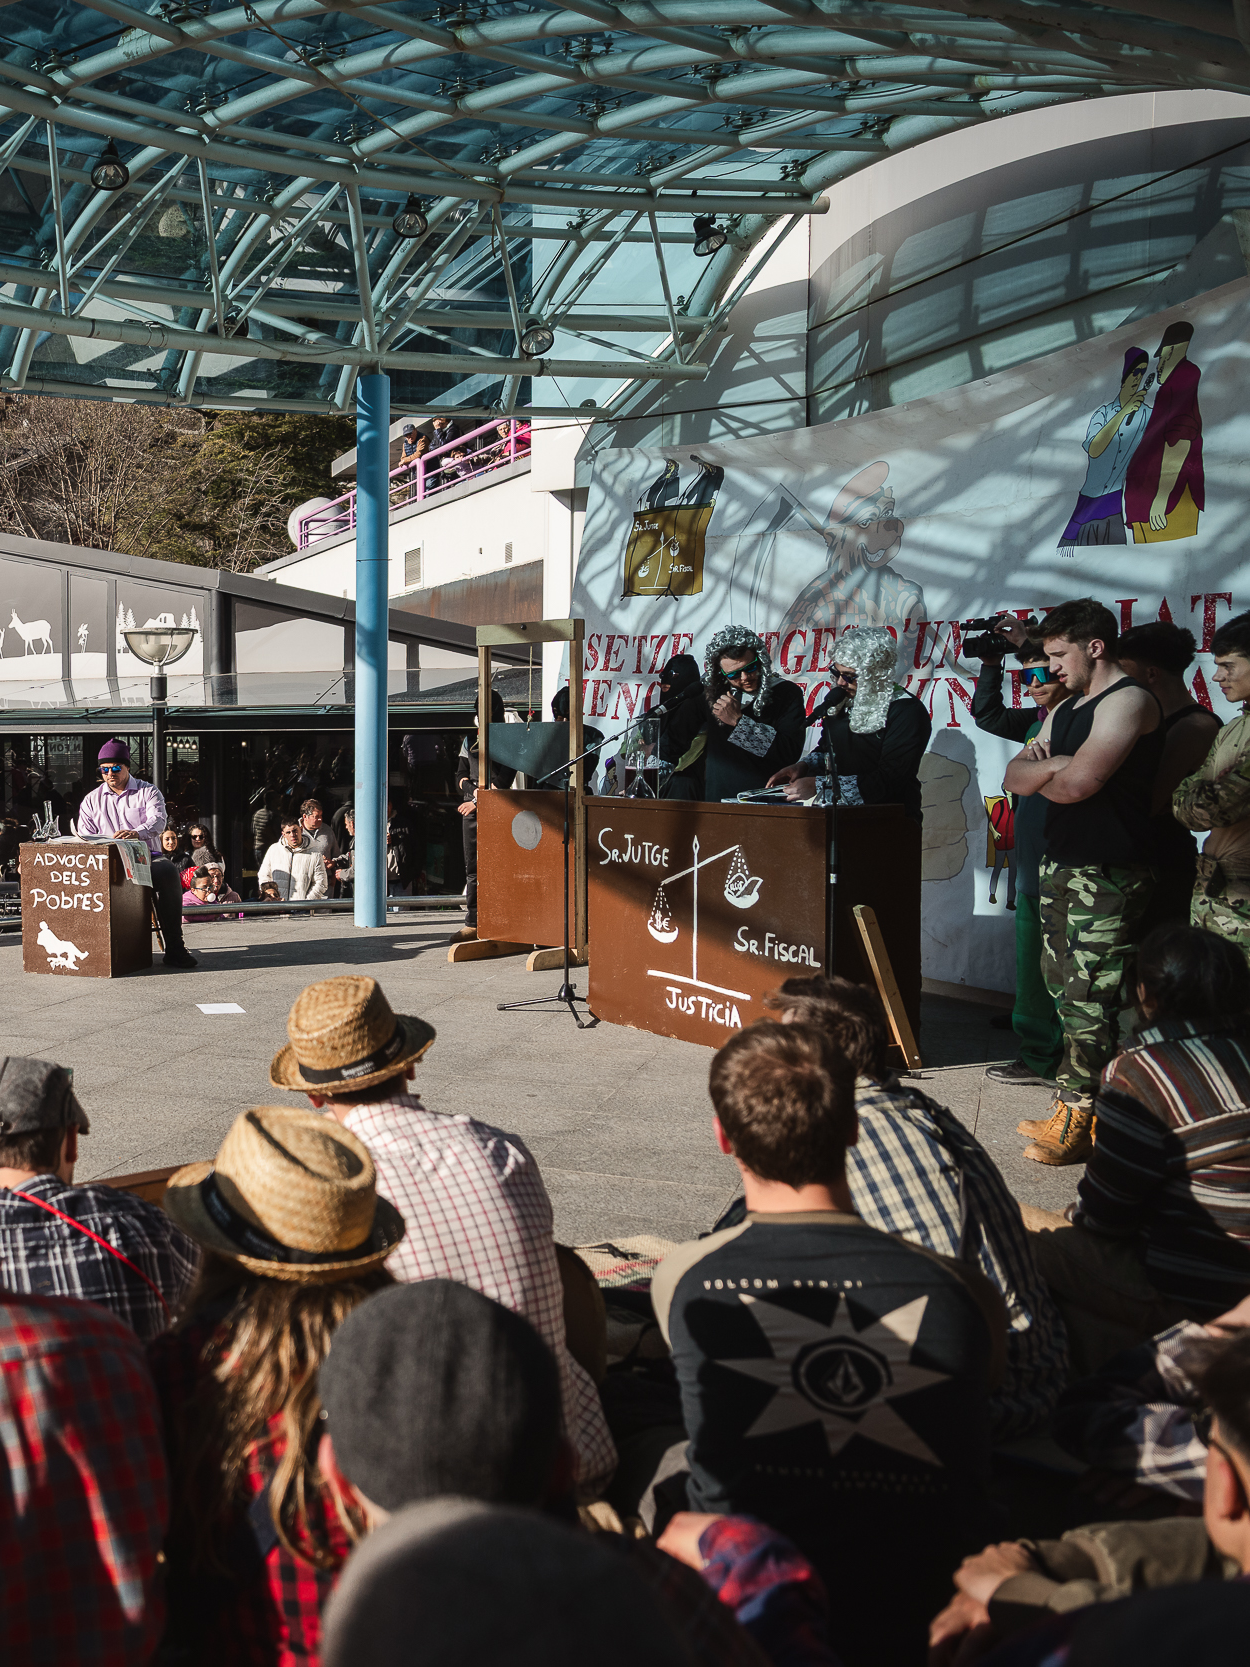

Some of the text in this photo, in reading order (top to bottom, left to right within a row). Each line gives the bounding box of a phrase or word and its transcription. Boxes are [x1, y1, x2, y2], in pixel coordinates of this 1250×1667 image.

[584, 632, 694, 674] SETZE
[34, 853, 108, 871] ADVOCAT
[50, 871, 90, 886] DELS
[703, 1278, 779, 1291] VOLCOM
